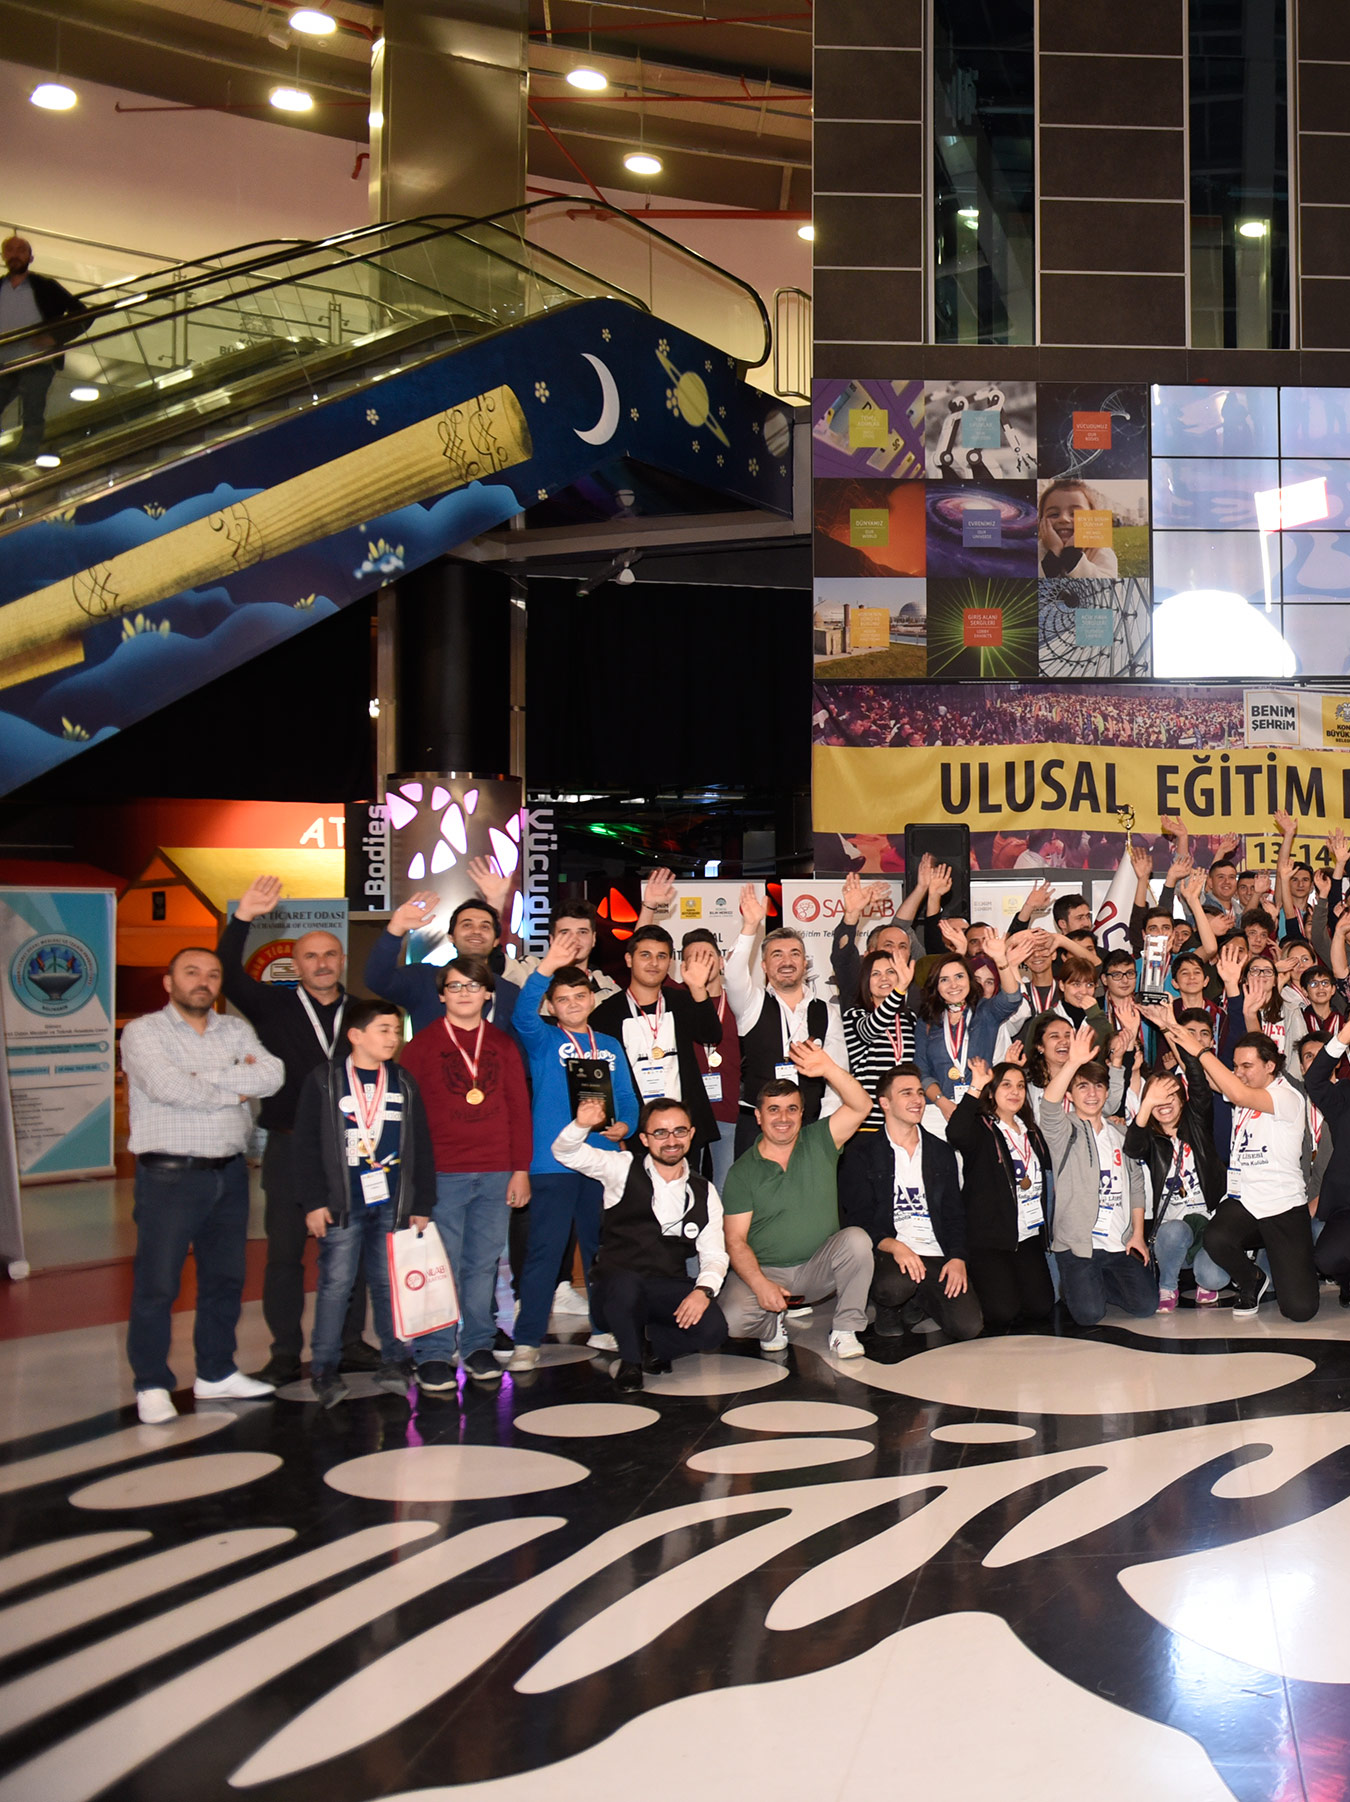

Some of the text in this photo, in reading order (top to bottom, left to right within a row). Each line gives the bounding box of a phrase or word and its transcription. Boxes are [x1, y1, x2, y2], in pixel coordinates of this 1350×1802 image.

[1251, 705, 1295, 718] BENİM
[1251, 719, 1296, 731] ŞEHRİM
[940, 758, 1132, 815] ULUSAL
[1157, 751, 1327, 818] EĞİTİM
[822, 898, 895, 918] SALAB
